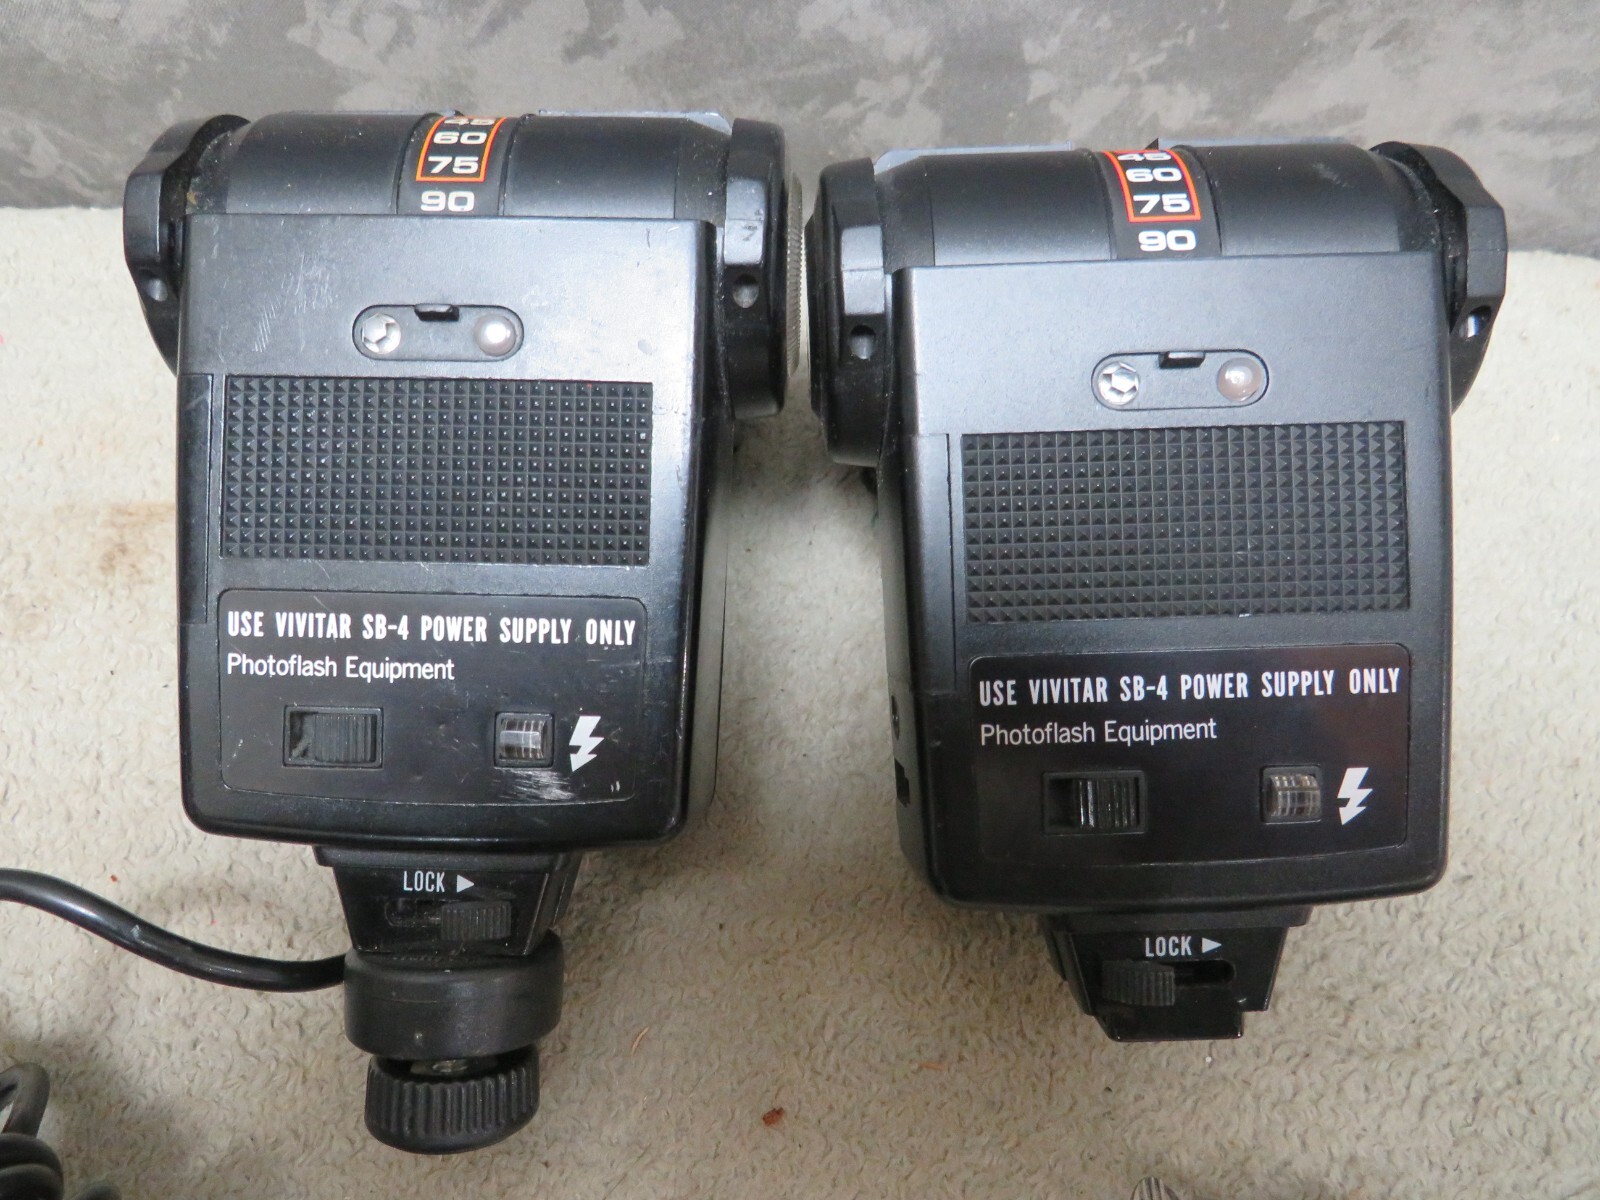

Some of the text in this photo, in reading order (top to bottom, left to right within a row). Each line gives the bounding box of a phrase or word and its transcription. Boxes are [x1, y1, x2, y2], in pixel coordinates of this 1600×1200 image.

[432, 131, 488, 145] 60
[427, 155, 479, 174] 75
[1125, 167, 1183, 182] 60
[420, 190, 475, 212] 90
[1132, 193, 1191, 214] 75
[1138, 229, 1197, 251] 90
[227, 610, 637, 647] USE VIVITAR SB-4 POWER SUPPLY ONLY
[226, 652, 455, 683] Photoflash Equipment
[979, 667, 1400, 706] USE VIVITAR SB-4 POWER SUPPLY ONLY
[980, 718, 1217, 746] Photoflash Equipment
[403, 870, 446, 893] LOCK
[1145, 936, 1192, 957] LOCK
